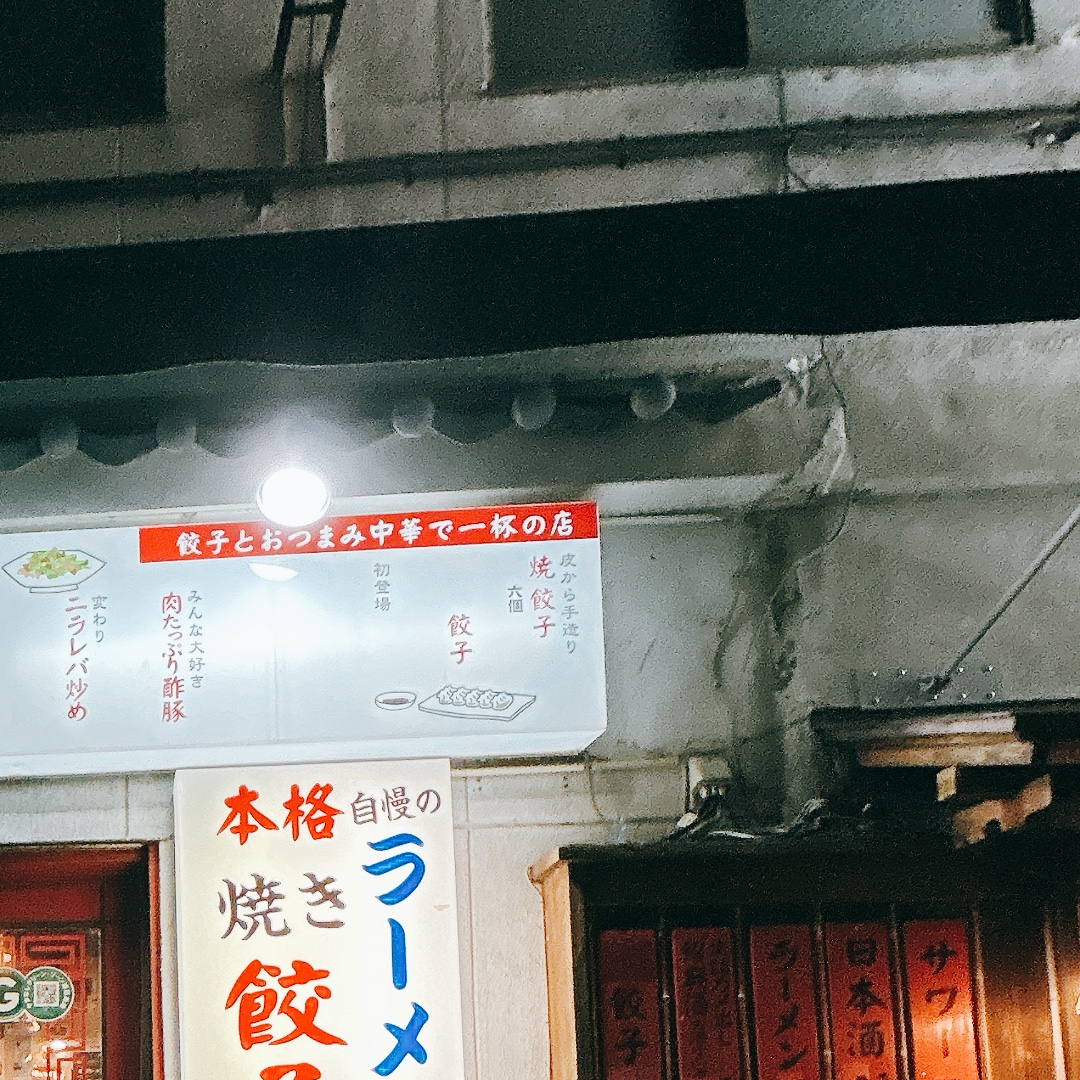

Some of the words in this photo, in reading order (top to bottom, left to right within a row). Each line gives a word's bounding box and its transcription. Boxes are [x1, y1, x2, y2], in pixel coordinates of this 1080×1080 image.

[176, 510, 574, 556] 餃子とおつまみ中華で一杯の店
[91, 595, 108, 643] 変わり
[373, 562, 390, 612] 初登場
[507, 585, 524, 614] 六個
[529, 555, 556, 638] 焼餃子
[559, 552, 579, 654] 皮から手造り
[65, 595, 89, 722] ニラレバ炒め
[161, 591, 187, 723] 肉たっぷり酢豚
[187, 589, 205, 688] みんな大好き
[447, 614, 473, 665] 餃子
[217, 783, 345, 846] 本格
[349, 785, 441, 826] 自慢の
[218, 873, 346, 941] 焼き
[768, 939, 807, 1071] ラーメン
[846, 937, 886, 1058] 日本酒
[920, 939, 959, 1058] サワー
